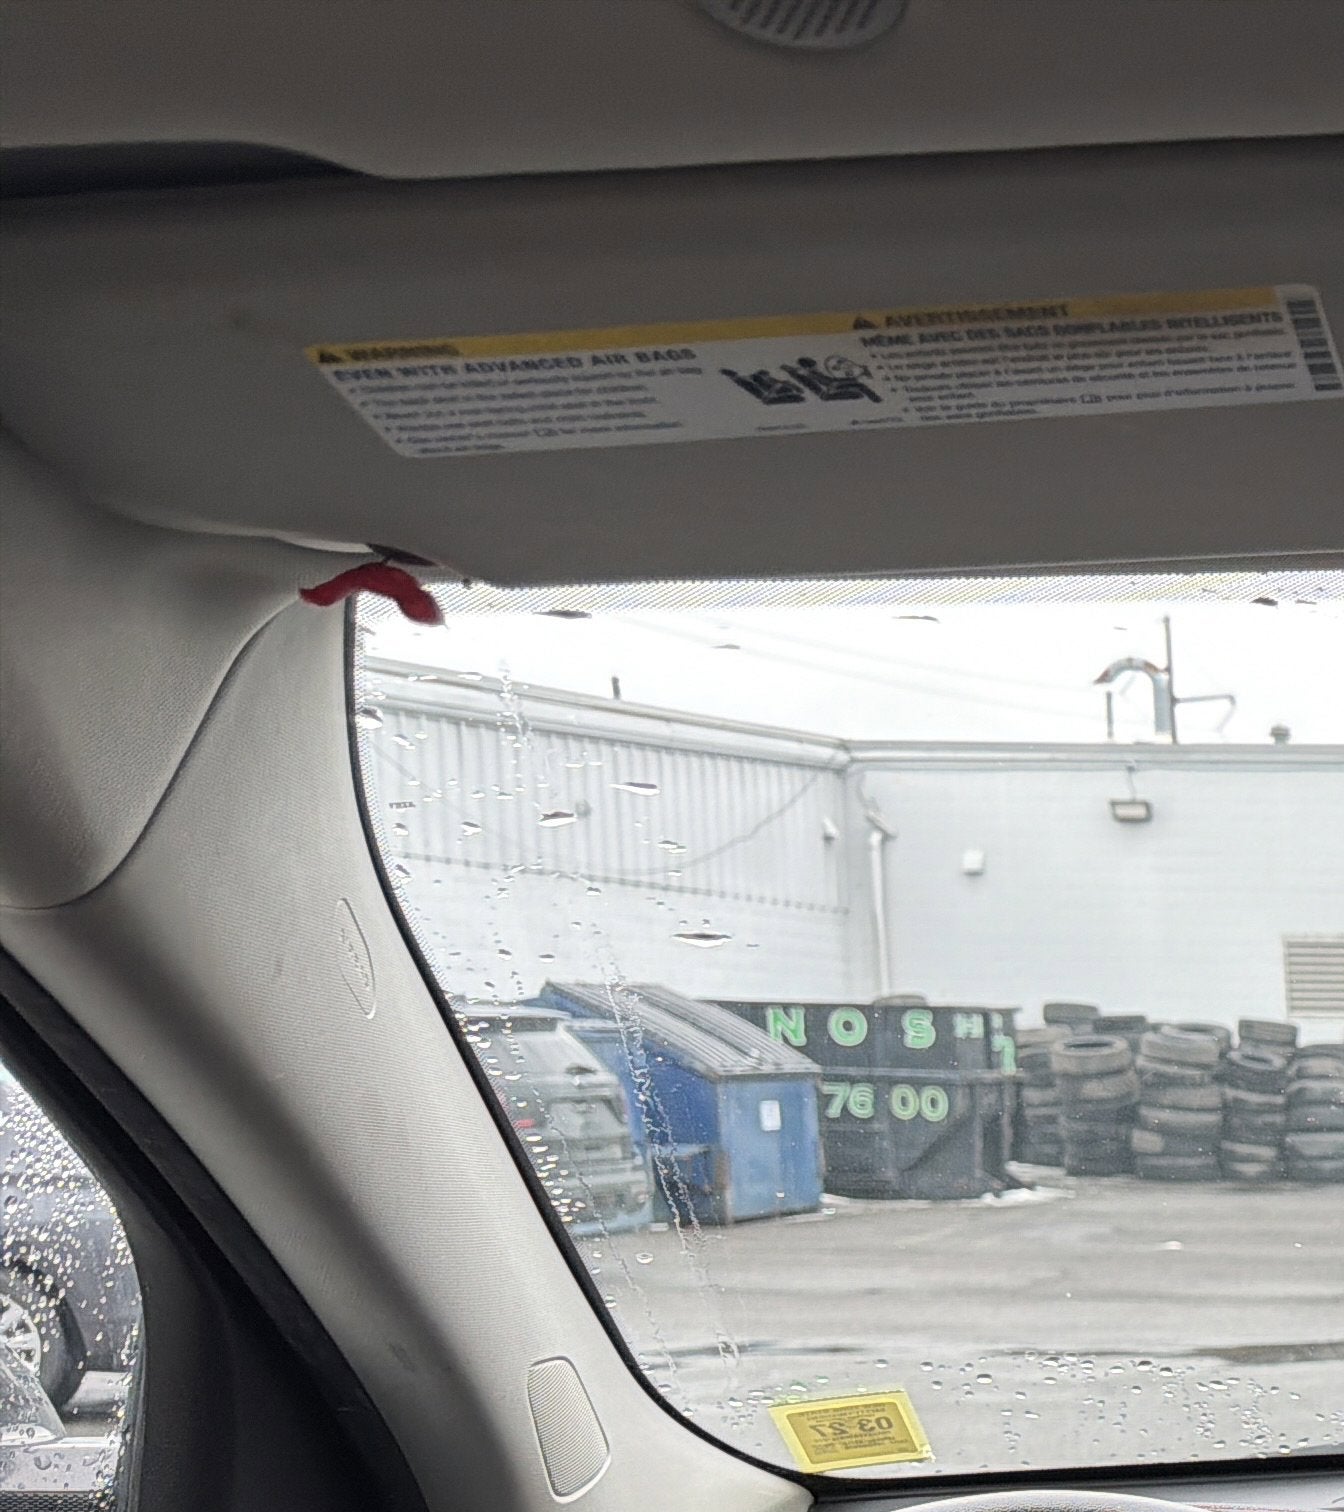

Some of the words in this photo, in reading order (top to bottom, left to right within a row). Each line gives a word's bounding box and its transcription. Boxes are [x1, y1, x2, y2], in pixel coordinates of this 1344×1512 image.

[333, 366, 392, 381] EVEN
[396, 363, 458, 378] WITH
[464, 356, 583, 373] ADVANCED
[591, 353, 630, 367] AIR
[635, 347, 697, 363] BAGS
